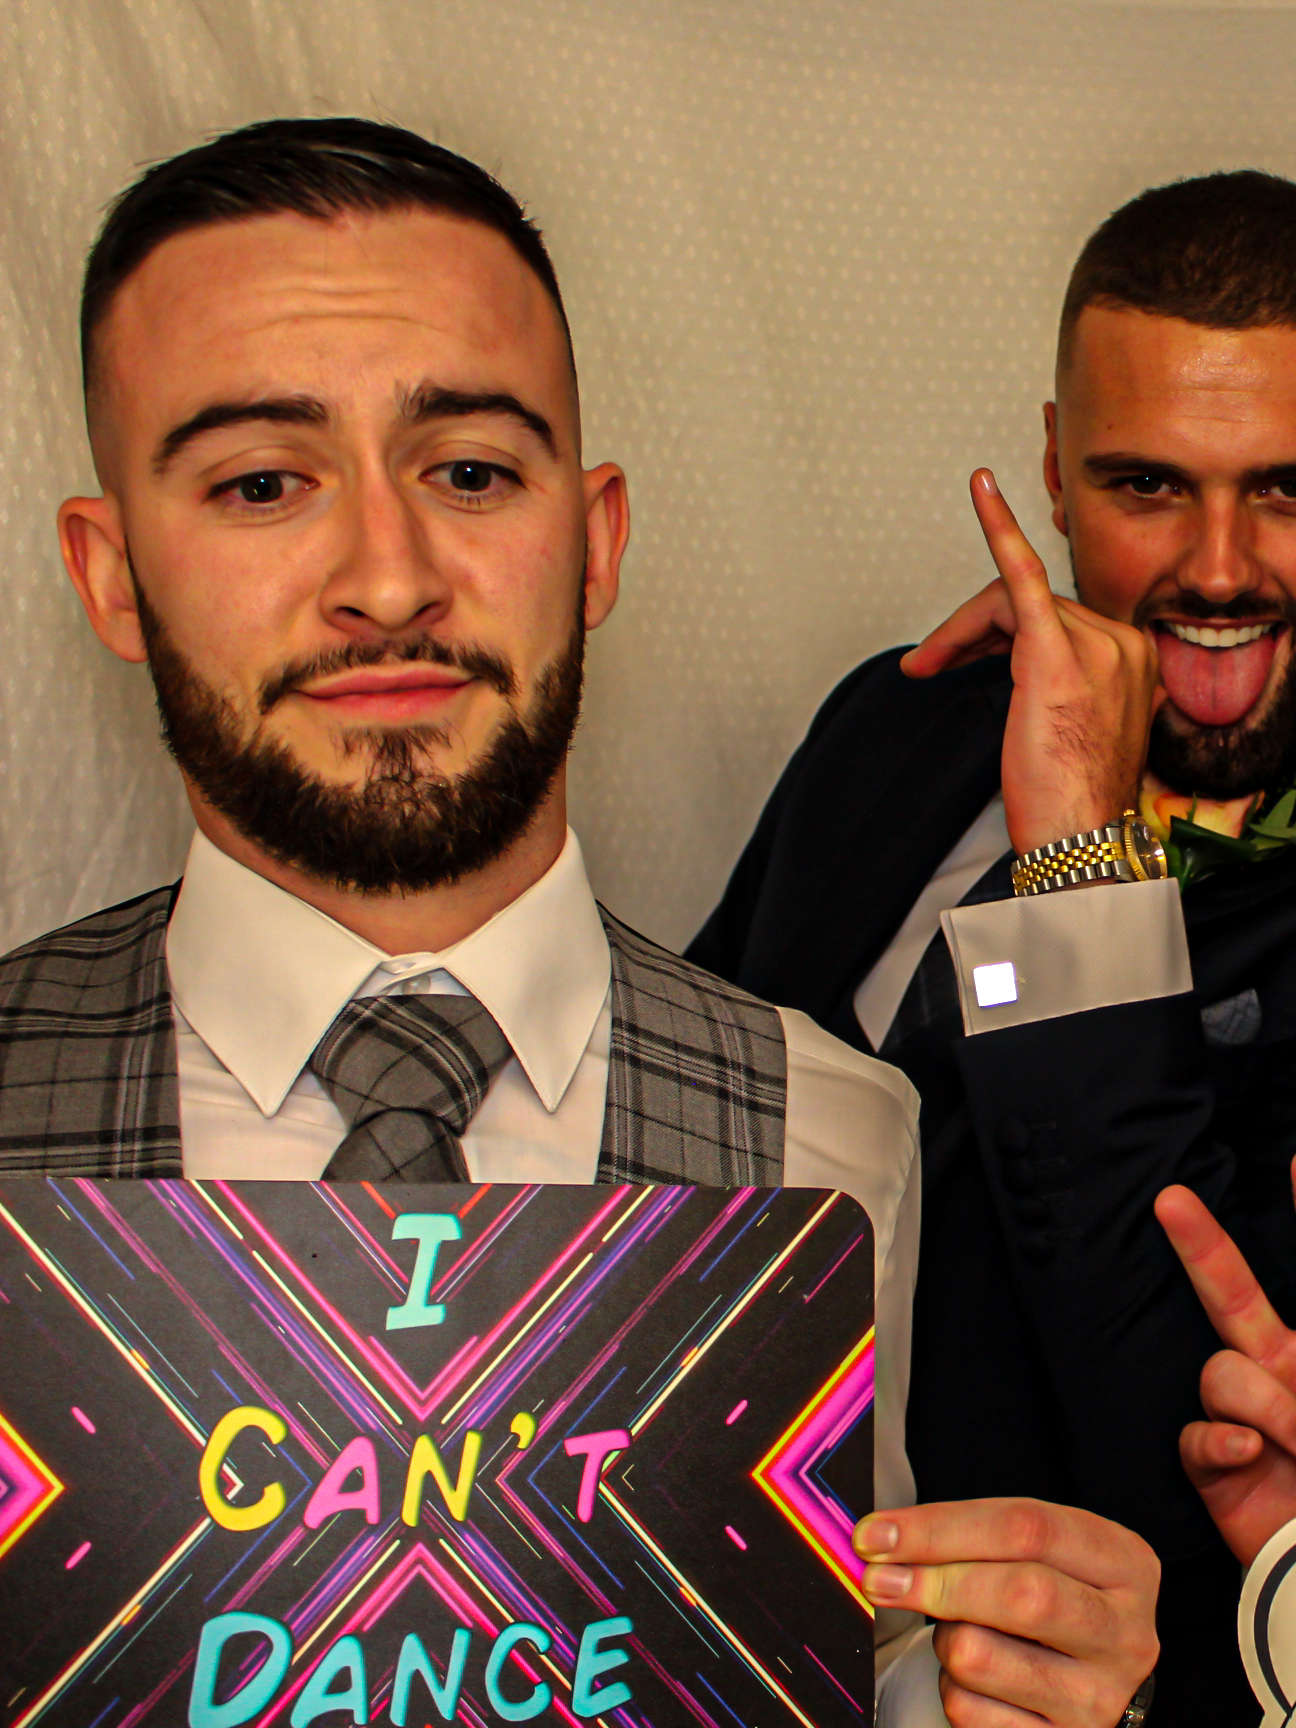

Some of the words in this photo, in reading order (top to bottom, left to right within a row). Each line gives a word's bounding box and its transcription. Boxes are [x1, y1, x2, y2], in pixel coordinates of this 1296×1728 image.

[386, 1213, 461, 1331] I
[199, 1406, 634, 1532] CAN'T
[188, 1611, 633, 1728] DANCE
